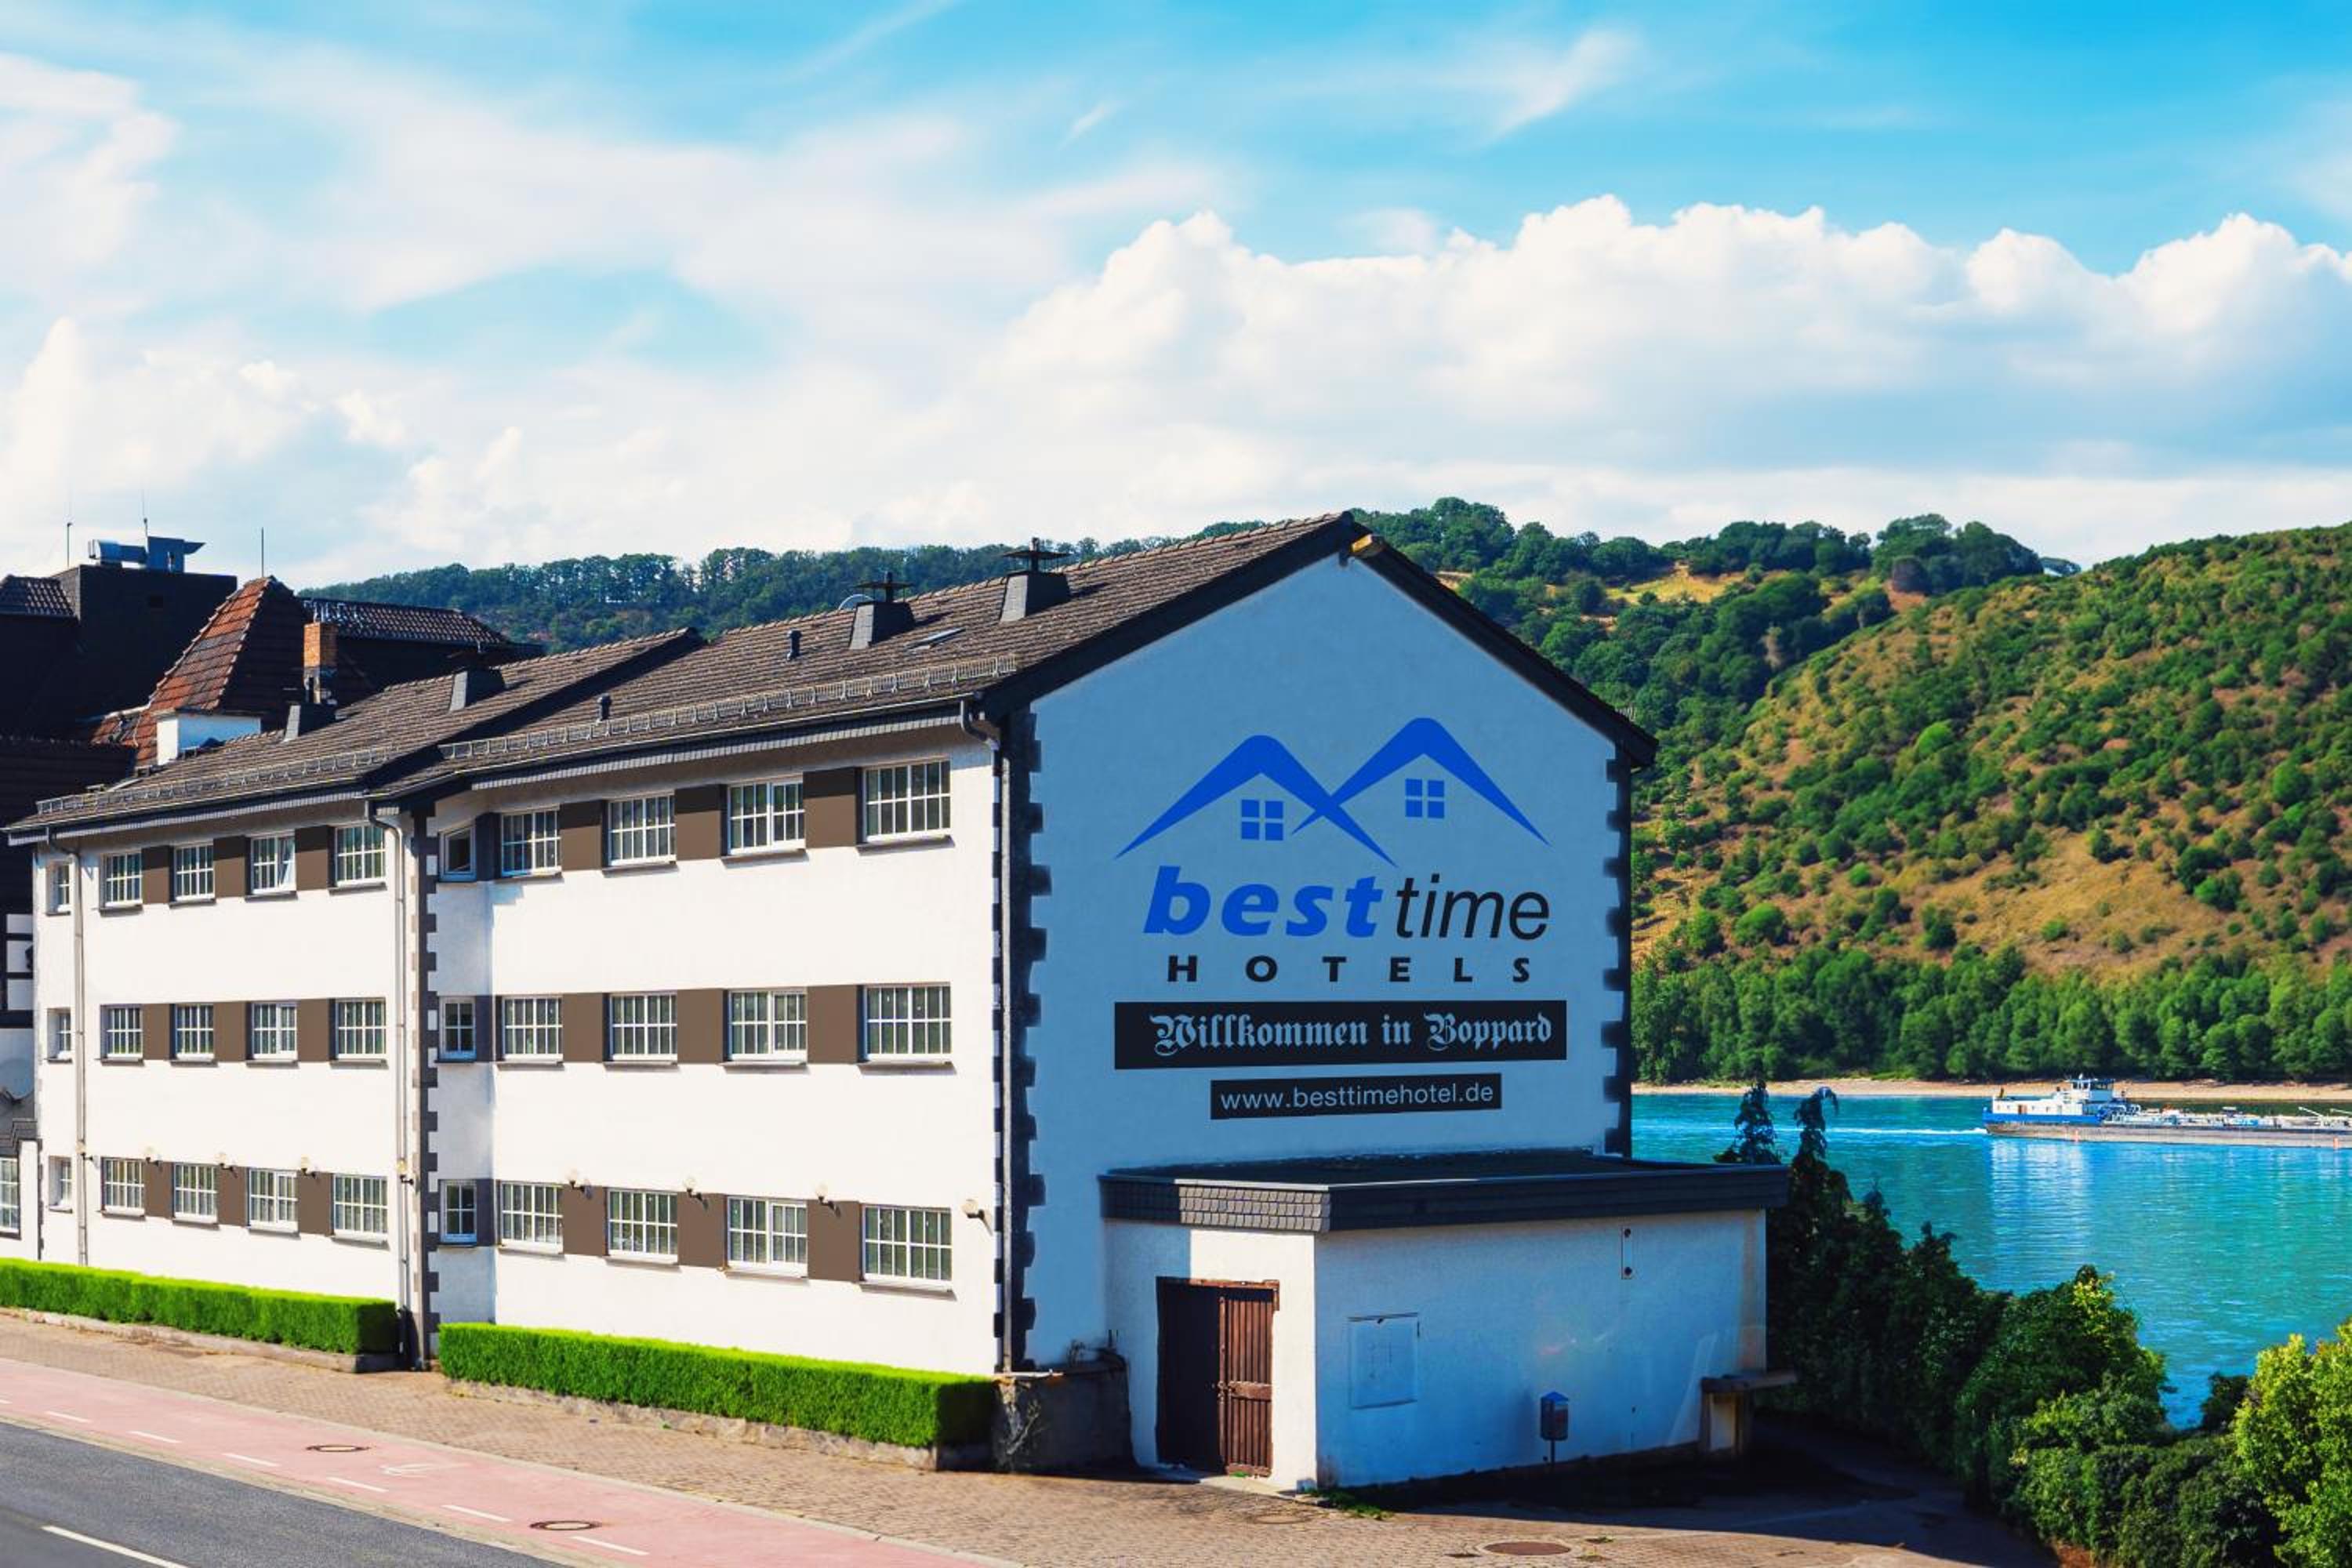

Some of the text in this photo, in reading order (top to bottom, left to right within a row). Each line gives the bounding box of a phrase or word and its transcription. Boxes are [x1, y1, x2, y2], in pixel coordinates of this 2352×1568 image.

[1167, 955, 1530, 983] HOTELS
[1150, 1012, 1552, 1056] Willkommen in Boppard
[1220, 1083, 1494, 1110] www.besttimehotel.de
